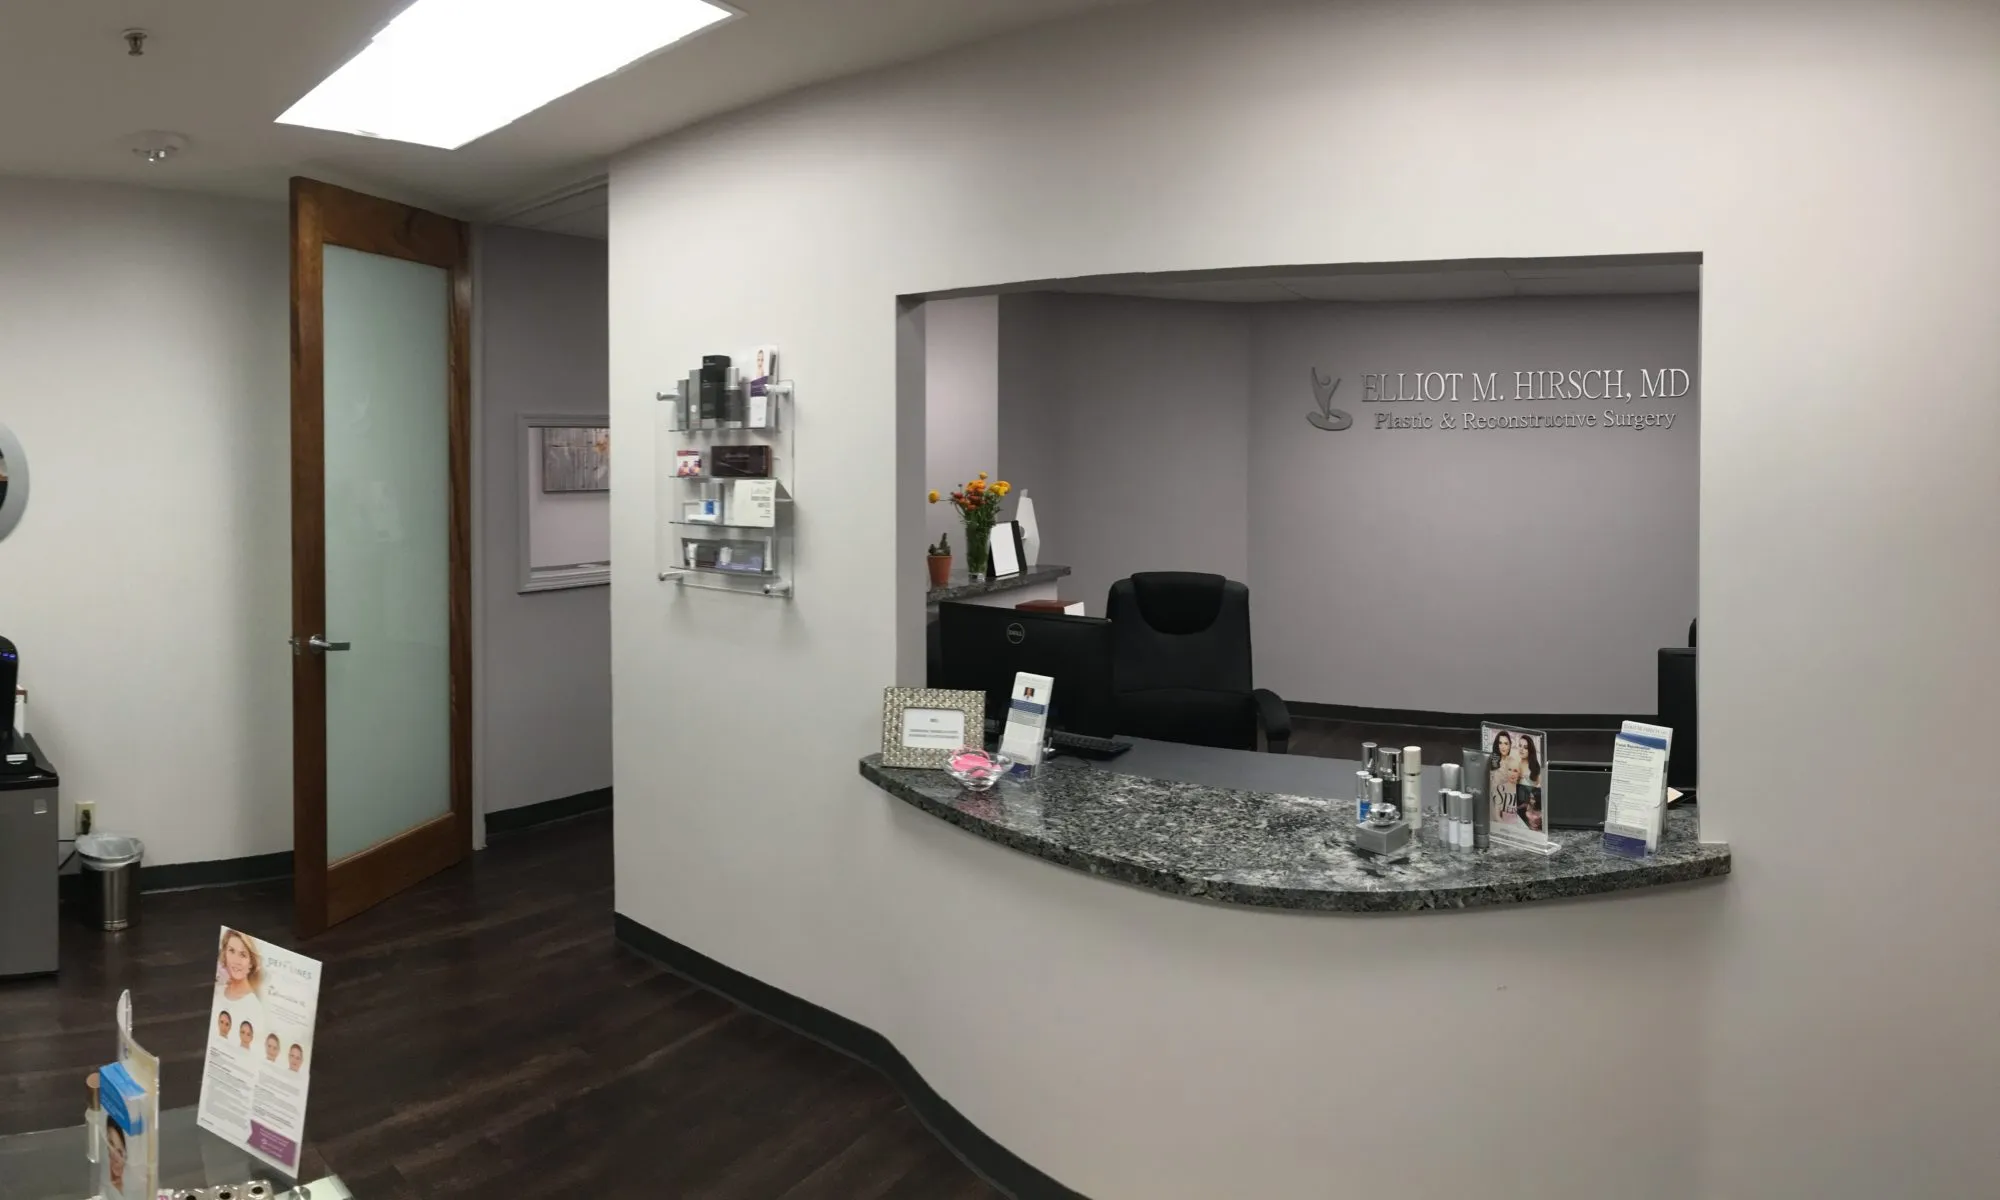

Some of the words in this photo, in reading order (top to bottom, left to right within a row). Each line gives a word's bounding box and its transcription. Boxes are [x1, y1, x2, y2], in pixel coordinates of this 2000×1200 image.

[1361, 371, 1465, 402] ELLIOT
[1472, 371, 1505, 402] M.
[1513, 369, 1632, 404] HIRSCH,
[1640, 368, 1690, 399] MD
[1374, 411, 1433, 430] Plastic
[1439, 411, 1457, 430] &
[1462, 410, 1597, 430] Reconstructive
[1603, 408, 1676, 430] Surgery
